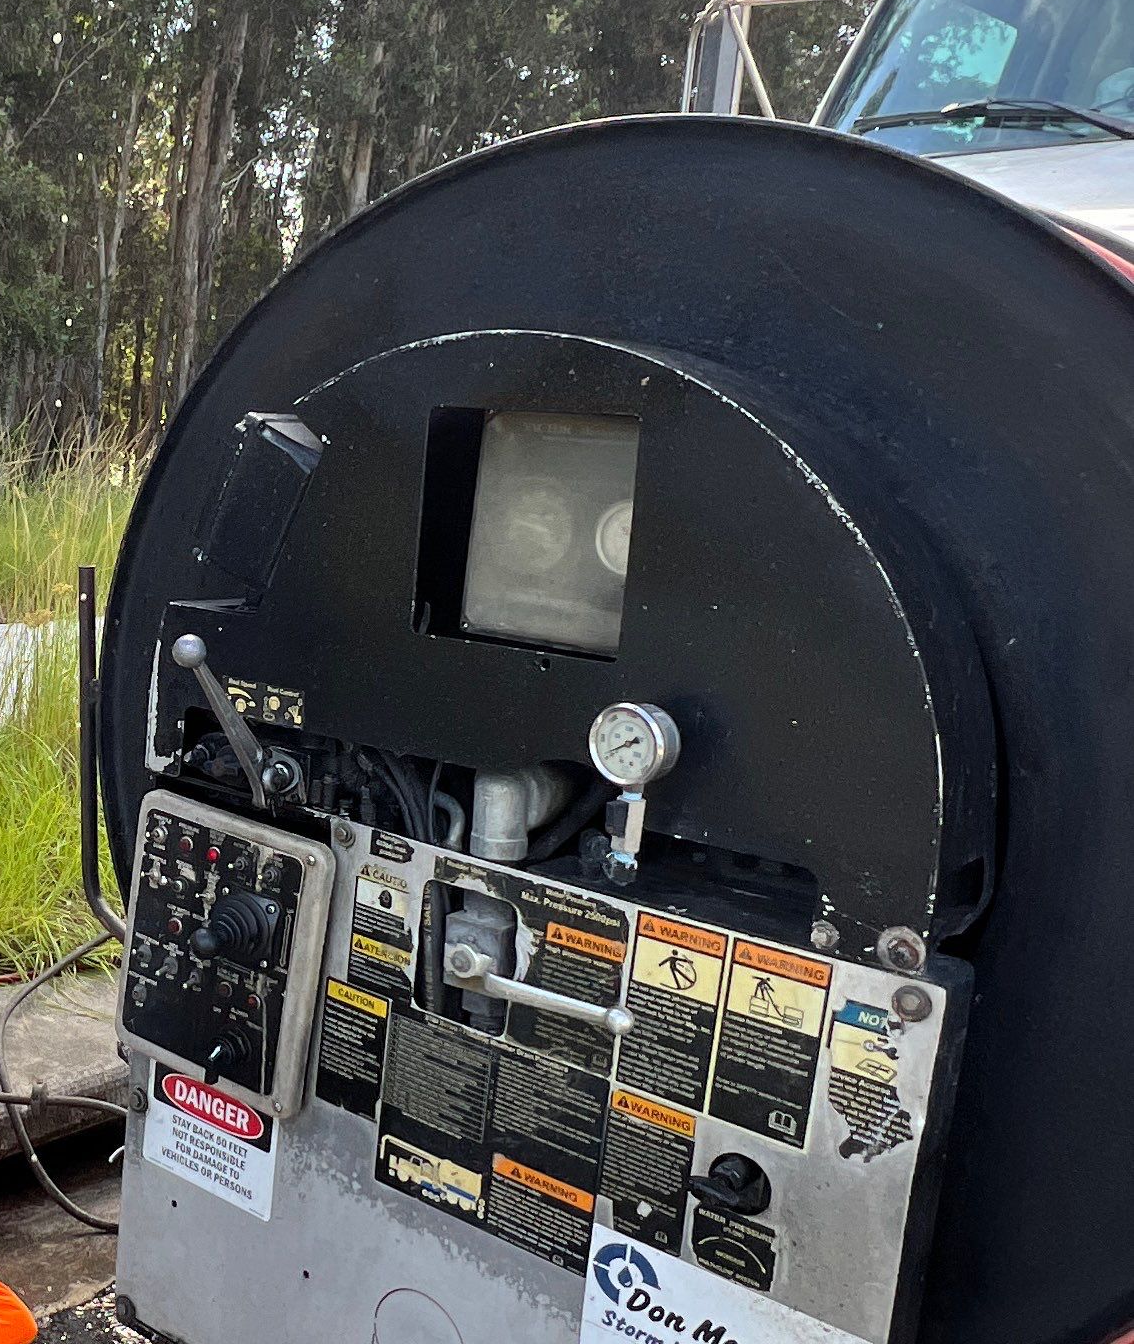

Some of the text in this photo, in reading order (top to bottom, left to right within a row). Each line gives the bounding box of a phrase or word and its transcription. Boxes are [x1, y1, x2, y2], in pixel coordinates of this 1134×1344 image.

[372, 868, 407, 888] CAUTIO
[543, 897, 584, 917] Pressure
[566, 932, 622, 958] WARNING
[660, 926, 722, 951] WARNING
[756, 952, 825, 982] WARNING
[338, 988, 375, 1010] CAUTION
[174, 1079, 250, 1133] DANGER
[630, 1101, 692, 1131] WARNING
[172, 1115, 191, 1131] STAY
[193, 1123, 215, 1142] BACK
[228, 1140, 248, 1158] FEET
[172, 1127, 188, 1142] NOT
[190, 1133, 246, 1171] RESPONSIBLE
[161, 1146, 199, 1172] VEHICLES
[201, 1167, 213, 1180] OR
[213, 1172, 253, 1200] PERSONS
[175, 1141, 191, 1156] FOR
[193, 1148, 228, 1174] DAMAGE
[229, 1166, 240, 1180] TO
[523, 1168, 578, 1203] WARNING
[626, 1287, 686, 1333] Don
